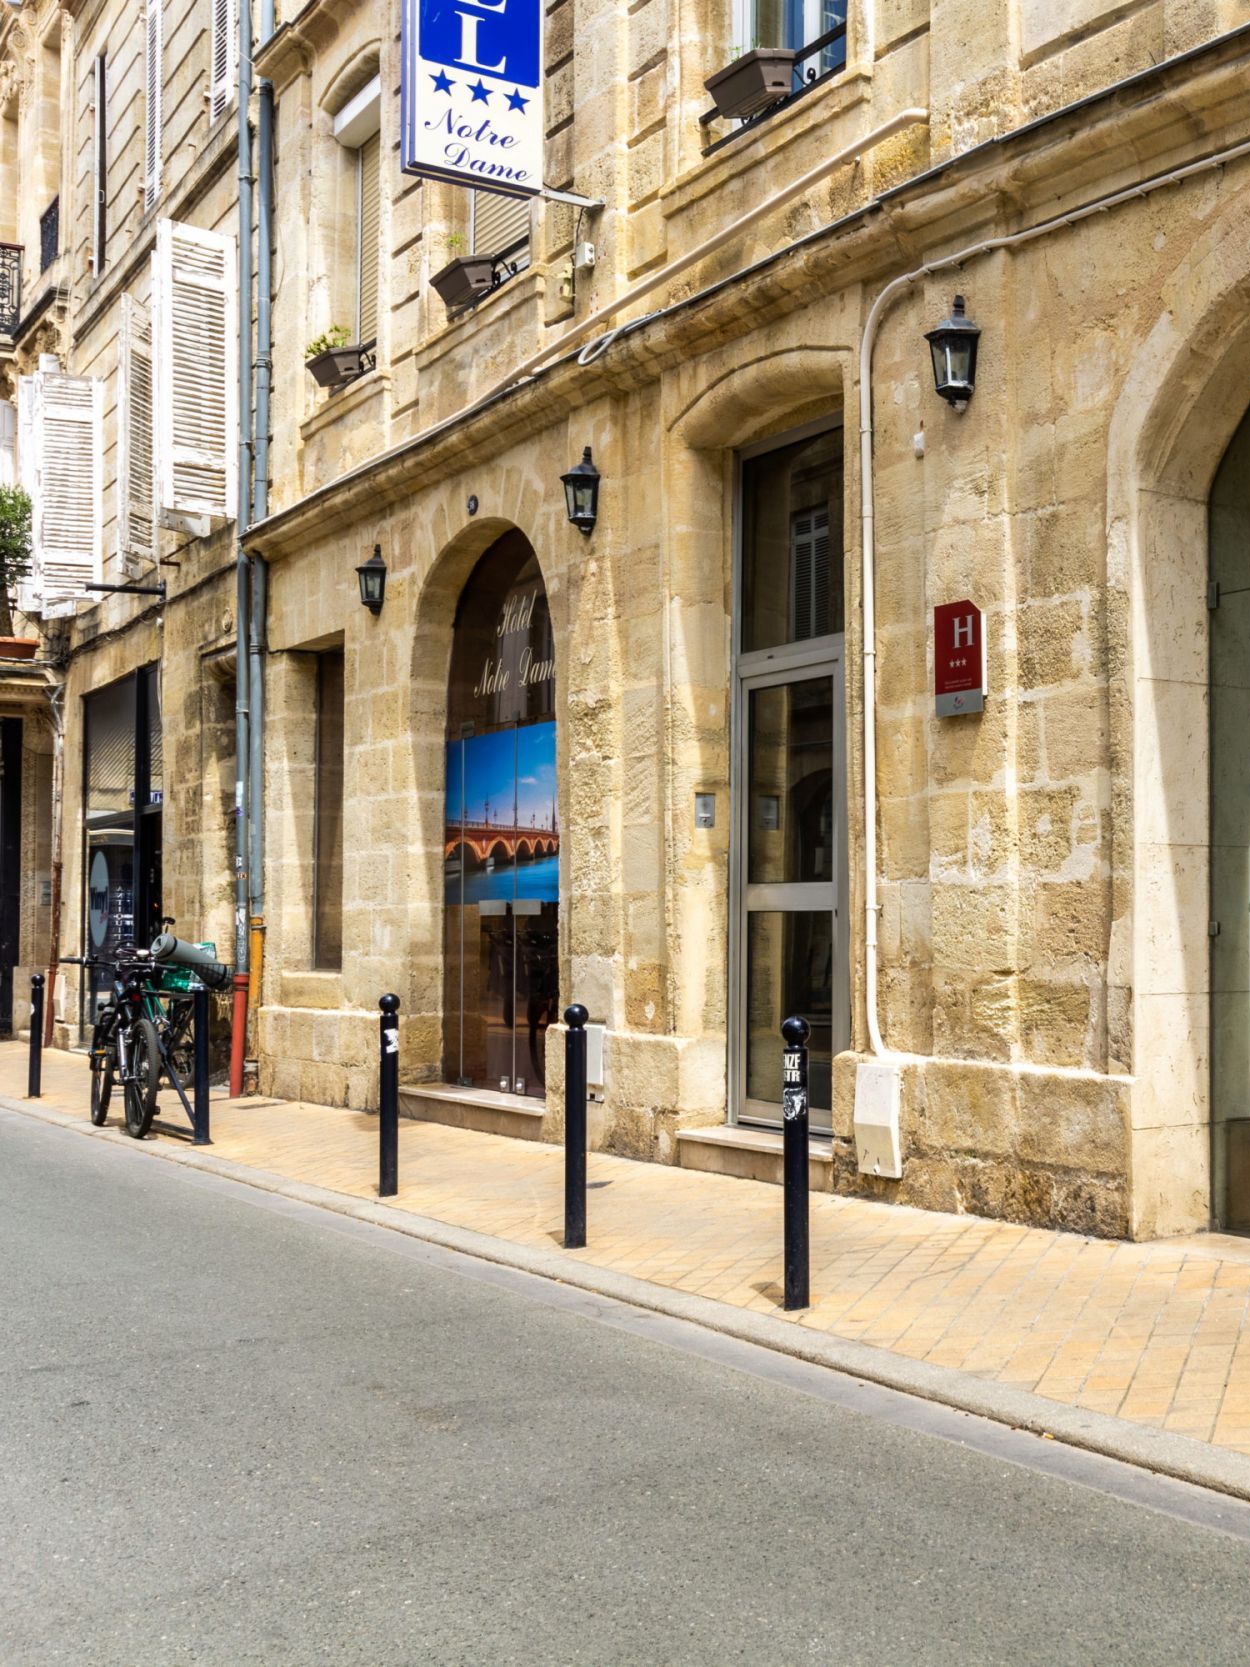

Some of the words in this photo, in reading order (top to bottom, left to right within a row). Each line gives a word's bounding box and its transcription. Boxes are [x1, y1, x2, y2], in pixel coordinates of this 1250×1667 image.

[424, 108, 520, 149] Notre
[444, 143, 533, 182] Dame
[497, 589, 537, 638] Hotel
[952, 614, 974, 649] H
[474, 658, 510, 698] Notre
